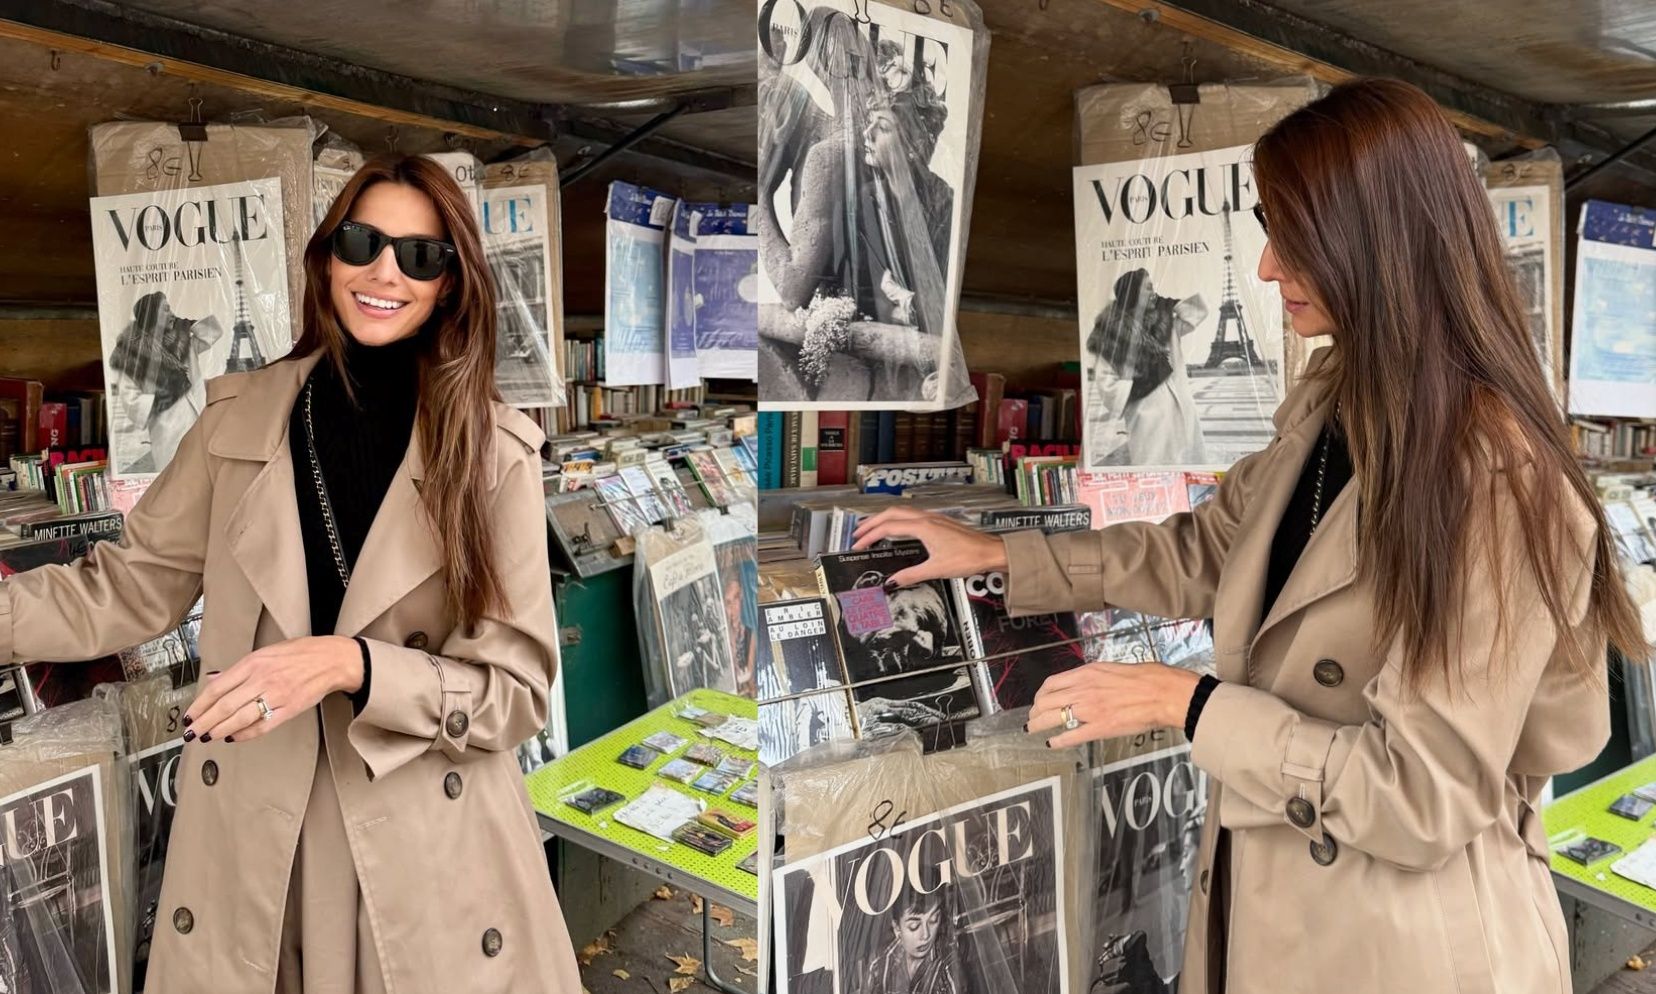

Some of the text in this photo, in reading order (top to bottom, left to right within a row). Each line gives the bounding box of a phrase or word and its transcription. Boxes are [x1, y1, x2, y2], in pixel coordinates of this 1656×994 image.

[772, 22, 800, 37] PARIS
[1088, 161, 1259, 226] VOGUE
[105, 194, 268, 252] VOGUE
[1101, 238, 1125, 249] HAUTE
[1102, 241, 1211, 262] L'ESPRIT PARISIEN
[120, 264, 144, 274] HAUTE
[121, 267, 222, 286] L'ESPRIT PARISIEN
[995, 515, 1041, 529] MINETTE
[1044, 511, 1089, 527] WALTERS
[34, 518, 123, 542] MINETTE WALTERS
[766, 604, 820, 617] ERIC
[768, 610, 821, 622] AMBLER
[771, 626, 824, 641] LE DANGER
[794, 620, 823, 630] LOIN
[1099, 762, 1207, 840] VOG
[0, 788, 79, 866] UE
[807, 801, 1034, 931] VOGUE
